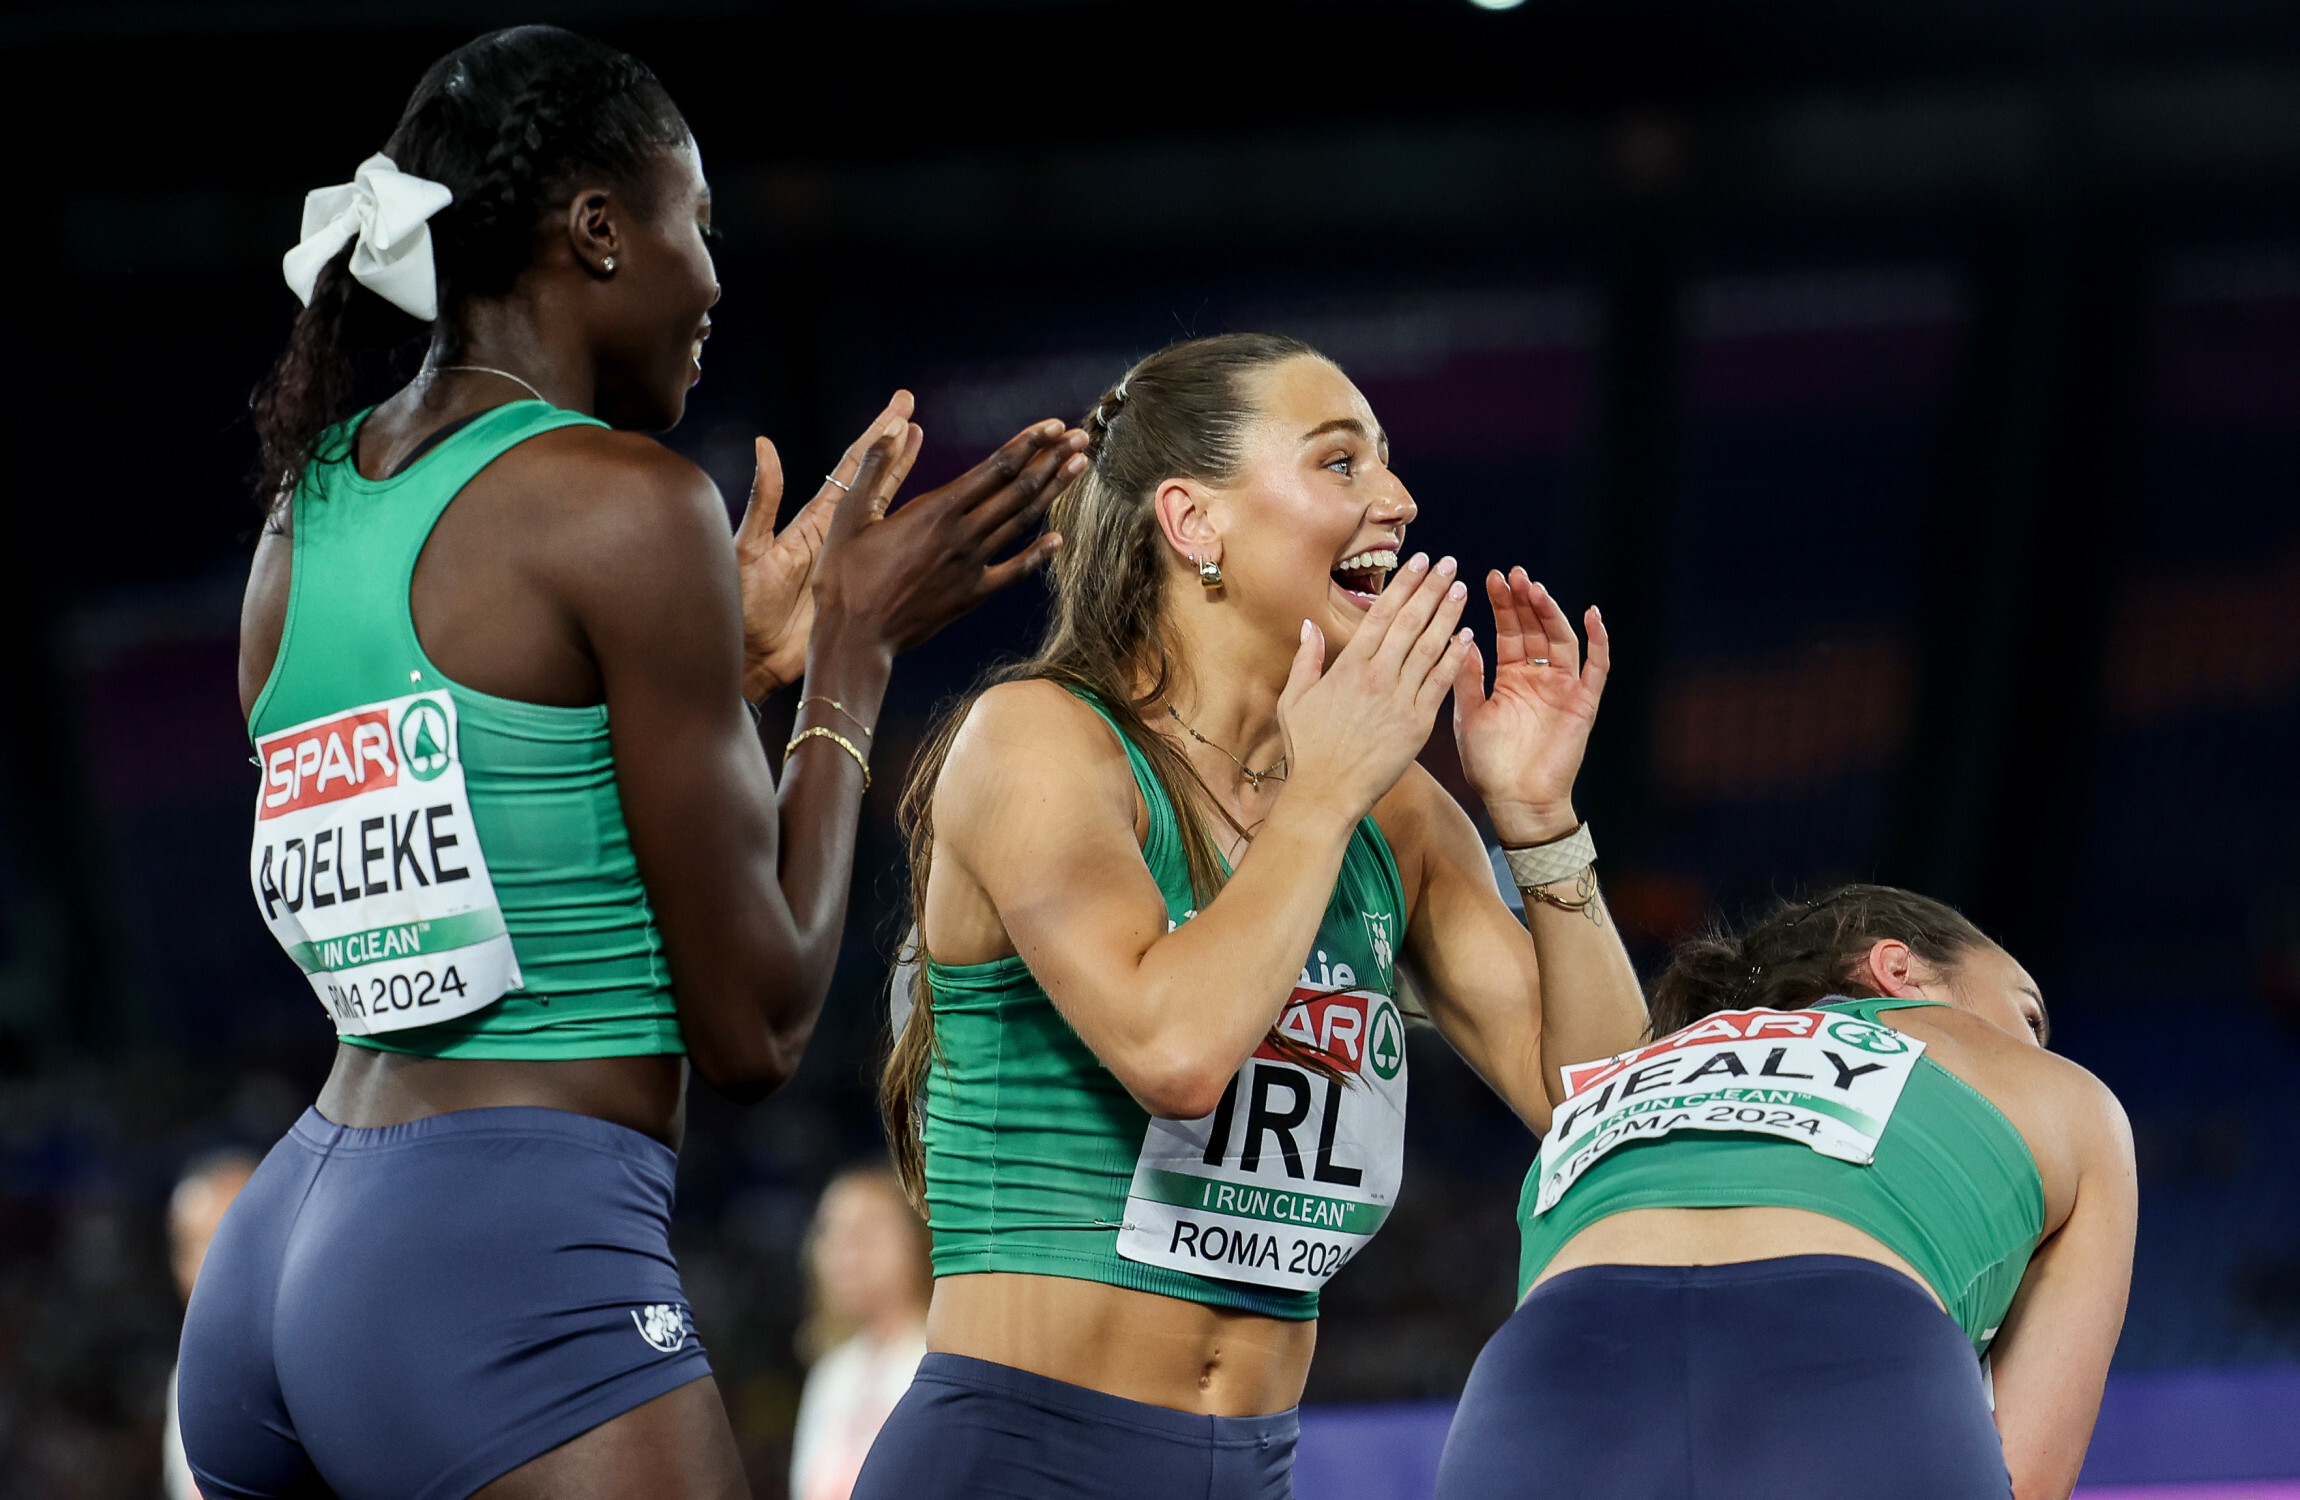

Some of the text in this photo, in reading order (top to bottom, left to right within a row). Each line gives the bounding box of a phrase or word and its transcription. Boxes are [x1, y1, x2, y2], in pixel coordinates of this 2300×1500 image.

[265, 721, 396, 809] SPAR
[260, 804, 471, 921] ADELEKE
[371, 965, 467, 1014] 2024
[1558, 1047, 1889, 1143] HEALY
[1606, 1098, 1676, 1127] RUN
[1705, 1106, 1822, 1136] 2024
[1202, 1062, 1364, 1188] IRL
[1202, 1182, 1212, 1207] I
[1216, 1186, 1270, 1216] RUN
[1169, 1219, 1353, 1277] ROMA 2024
